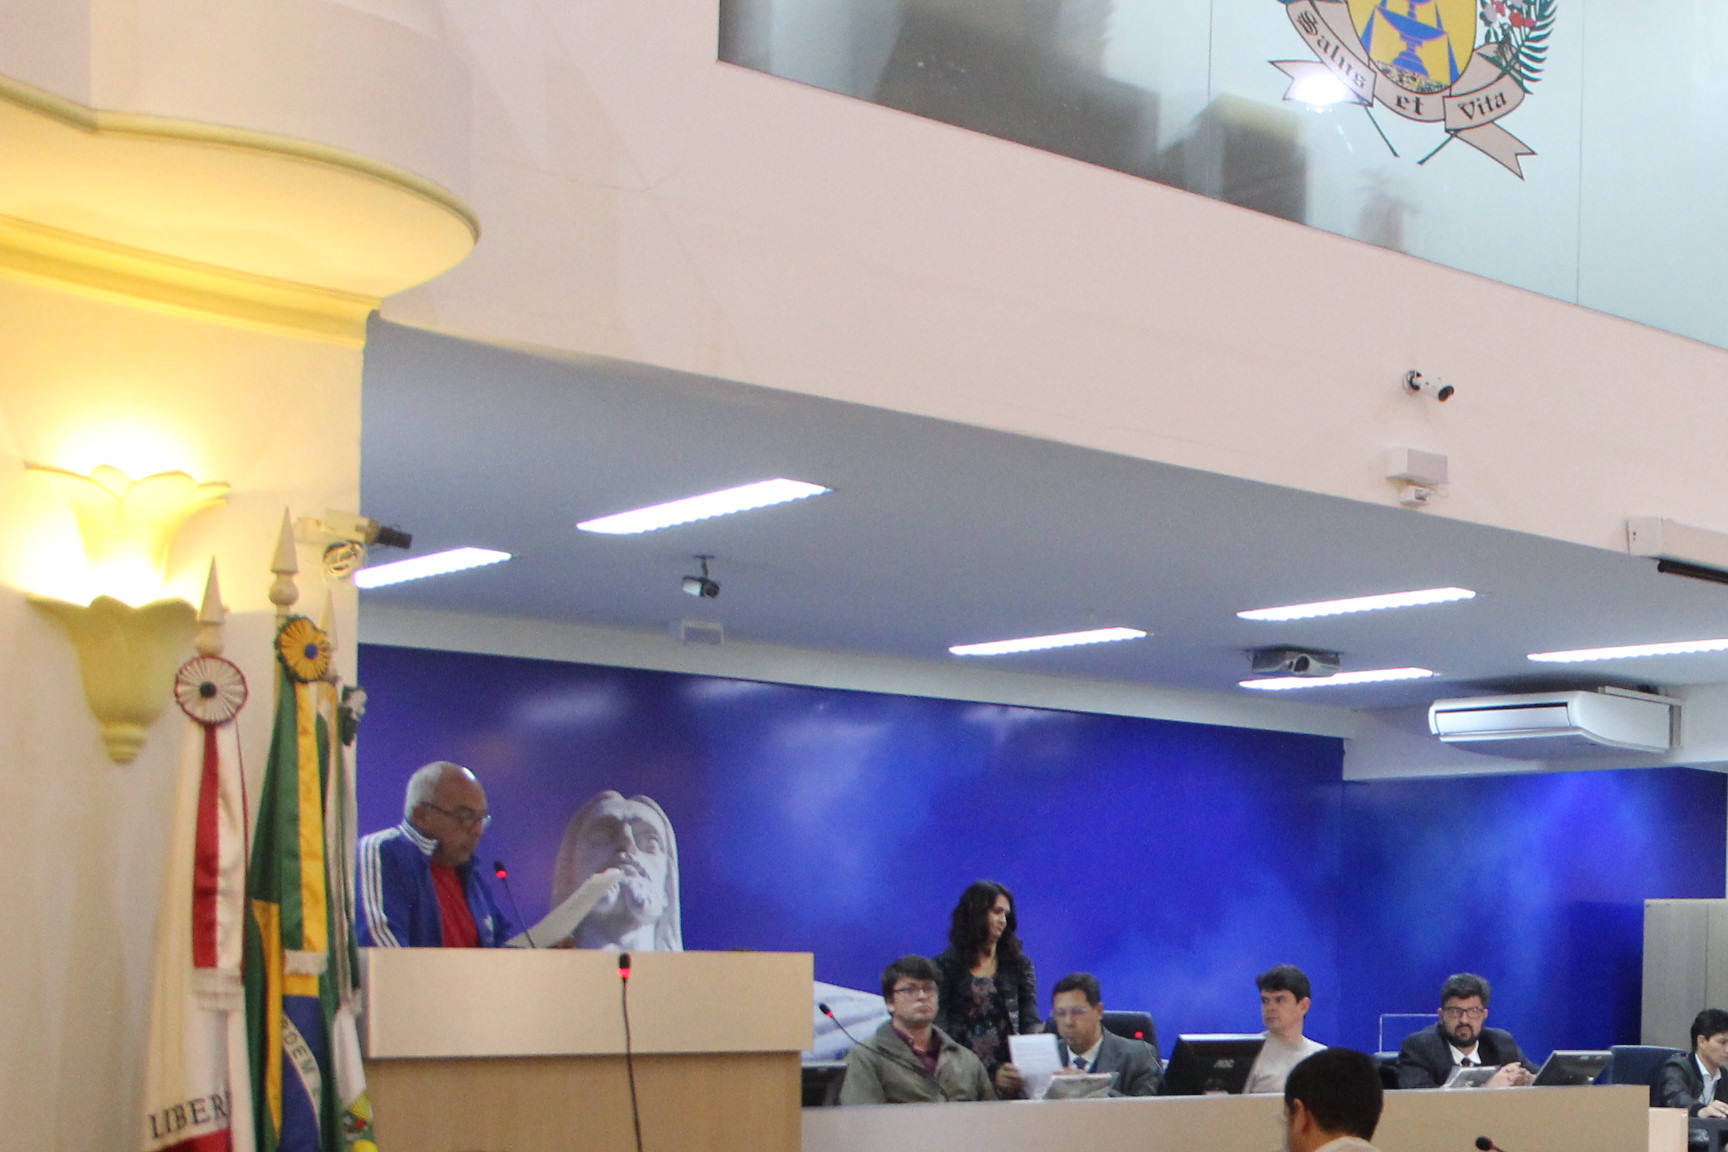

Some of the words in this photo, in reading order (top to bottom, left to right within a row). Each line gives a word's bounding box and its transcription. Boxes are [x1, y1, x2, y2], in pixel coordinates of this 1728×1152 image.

[1296, 10, 1367, 90] Salus
[1395, 93, 1425, 116] et
[1457, 90, 1508, 120] Vita
[147, 1091, 229, 1138] LIBER
